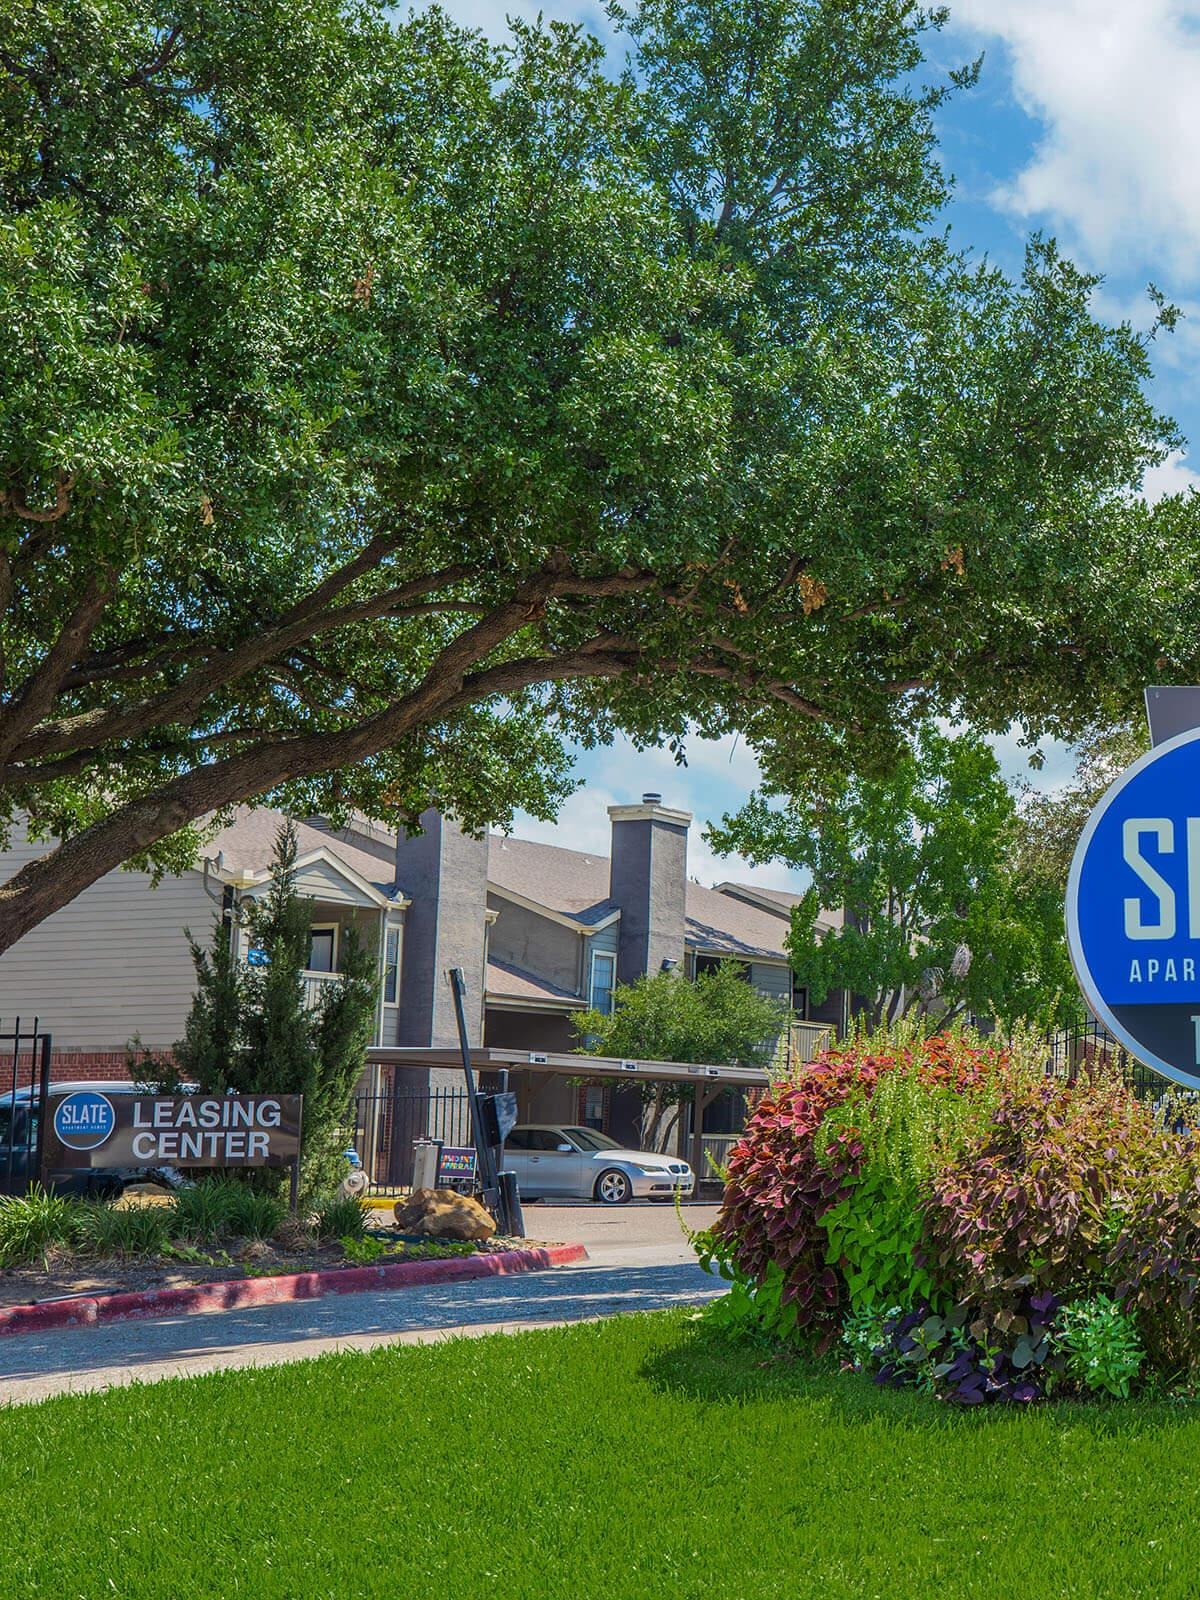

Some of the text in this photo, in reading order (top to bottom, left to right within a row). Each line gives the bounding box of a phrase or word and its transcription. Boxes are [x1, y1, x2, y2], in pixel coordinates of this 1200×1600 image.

[62, 1104, 107, 1124] SLATE
[133, 1100, 281, 1128] LEASING
[132, 1131, 270, 1159] CENTER
